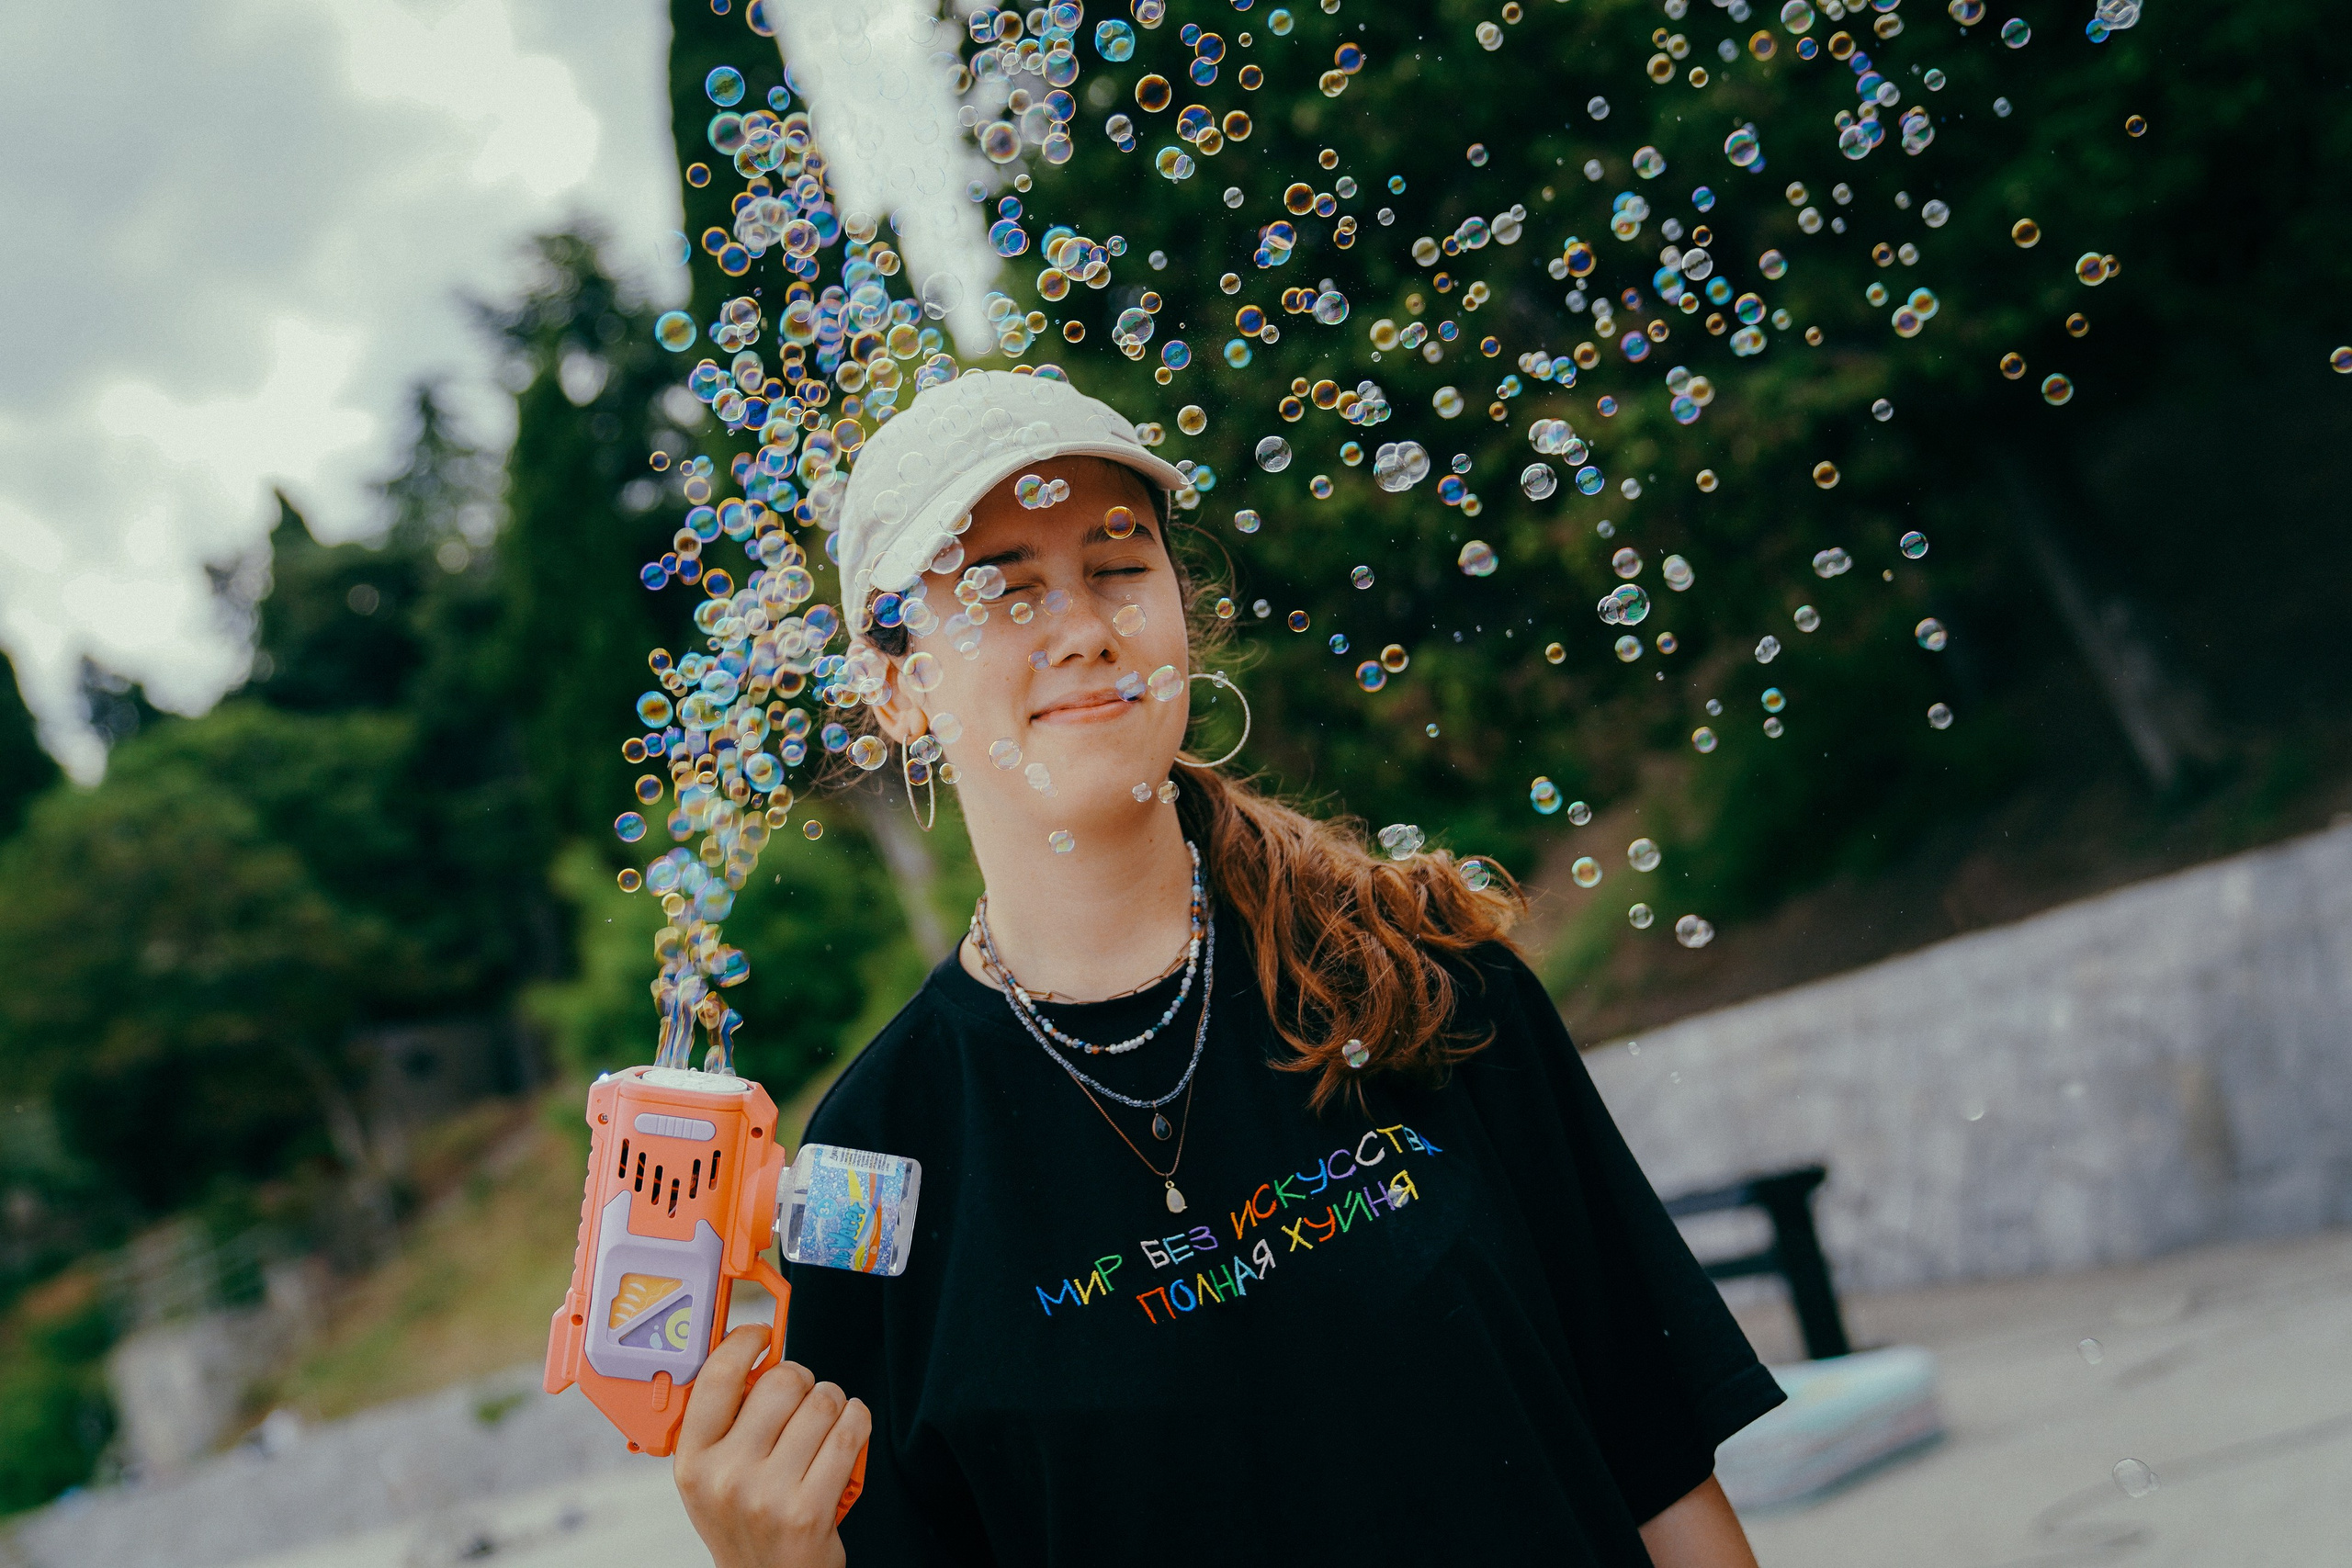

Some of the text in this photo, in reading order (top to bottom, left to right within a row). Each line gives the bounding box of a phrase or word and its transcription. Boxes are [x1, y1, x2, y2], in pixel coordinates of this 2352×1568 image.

[827, 1201, 865, 1249] Water
[1036, 1124, 1442, 1315] МИР БЕЗ ИСКУССТВА
[1137, 1170, 1419, 1324] ПОЛНАЯ ХУЙНЯ
